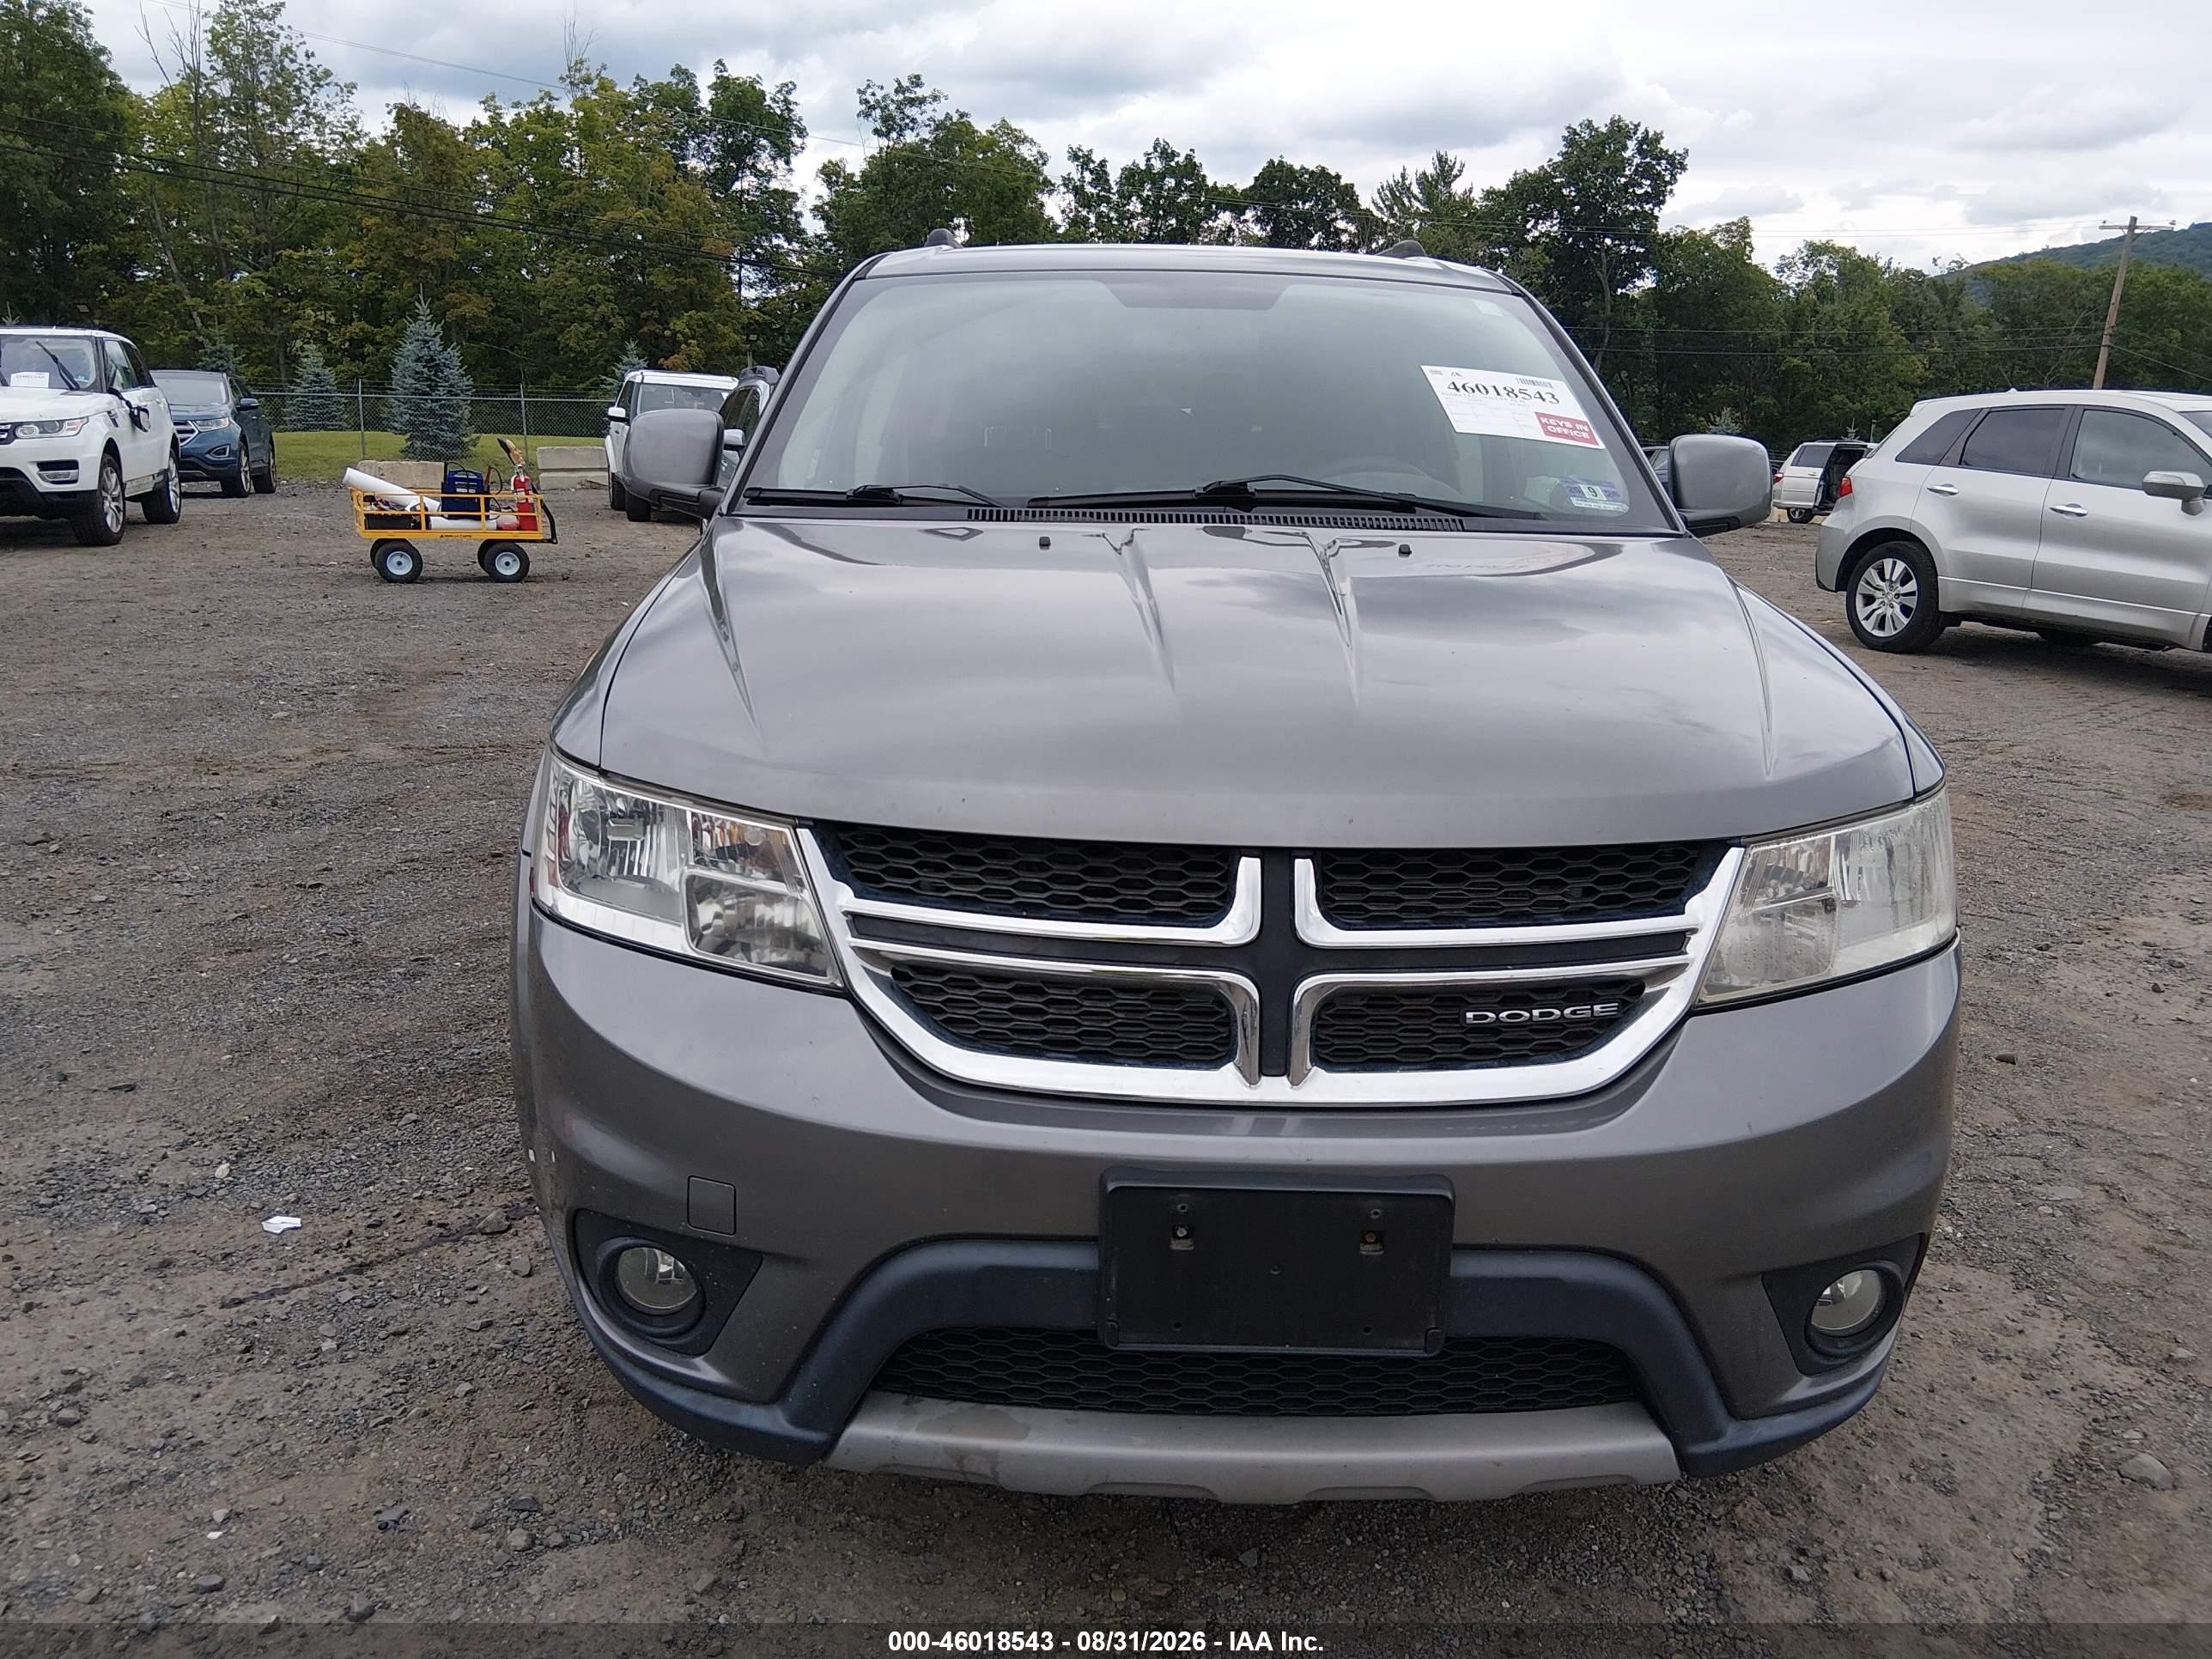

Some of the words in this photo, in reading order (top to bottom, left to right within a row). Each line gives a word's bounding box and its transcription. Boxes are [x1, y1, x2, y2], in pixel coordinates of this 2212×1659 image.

[1446, 380, 1559, 404] 46018543
[1540, 416, 1573, 428] KEYS
[1575, 423, 1589, 432] IN
[1547, 425, 1590, 440] OFFICE
[1587, 486, 1598, 497] 9
[1466, 1003, 1619, 1024] DODGE
